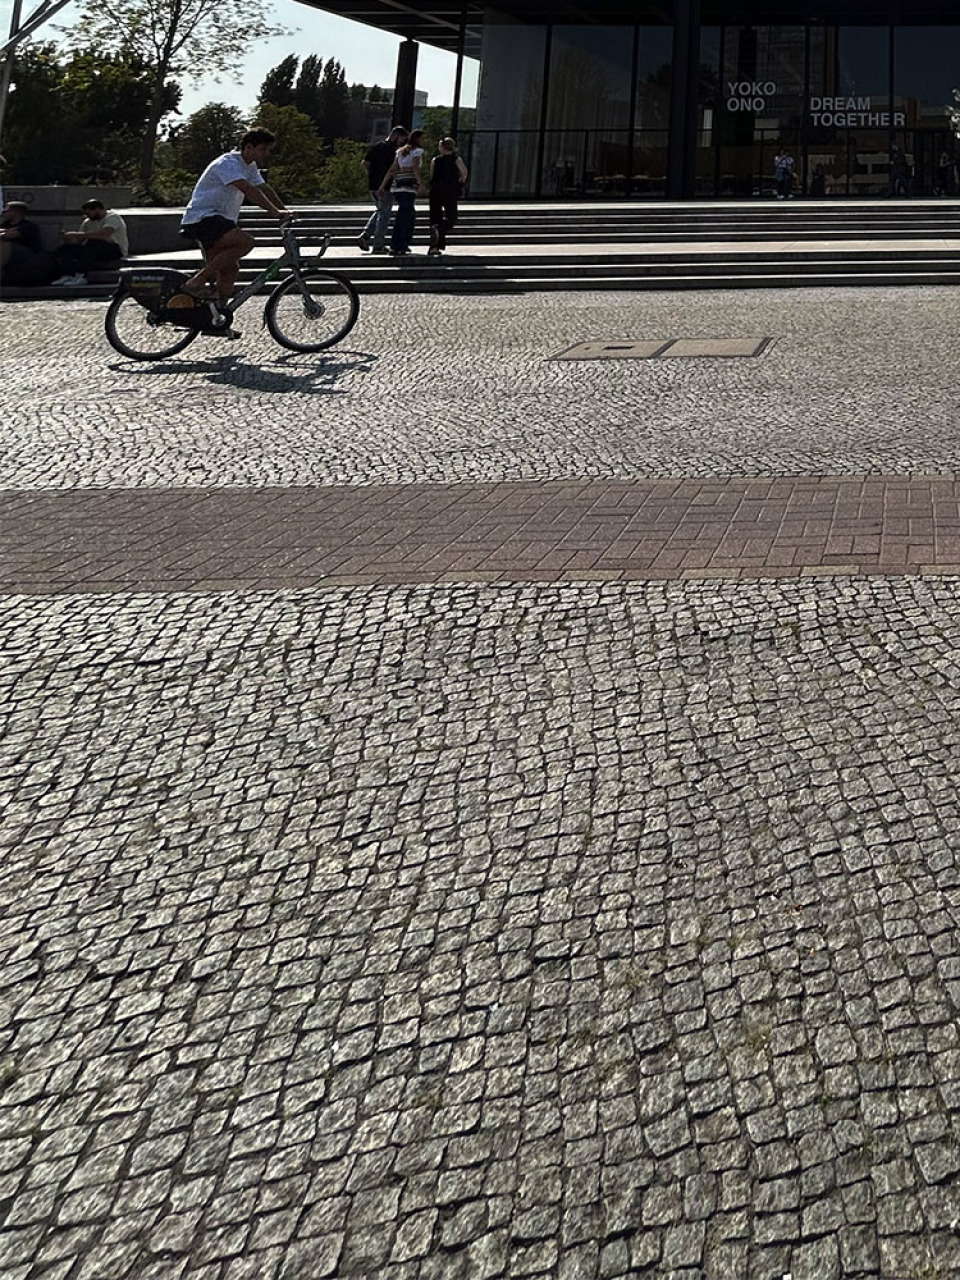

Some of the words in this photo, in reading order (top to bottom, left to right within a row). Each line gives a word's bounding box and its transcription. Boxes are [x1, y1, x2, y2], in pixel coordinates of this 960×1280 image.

[727, 81, 776, 95] YOKO
[726, 97, 765, 112] ONO
[809, 97, 870, 111] DREAM
[810, 112, 906, 127] TOGETHER
